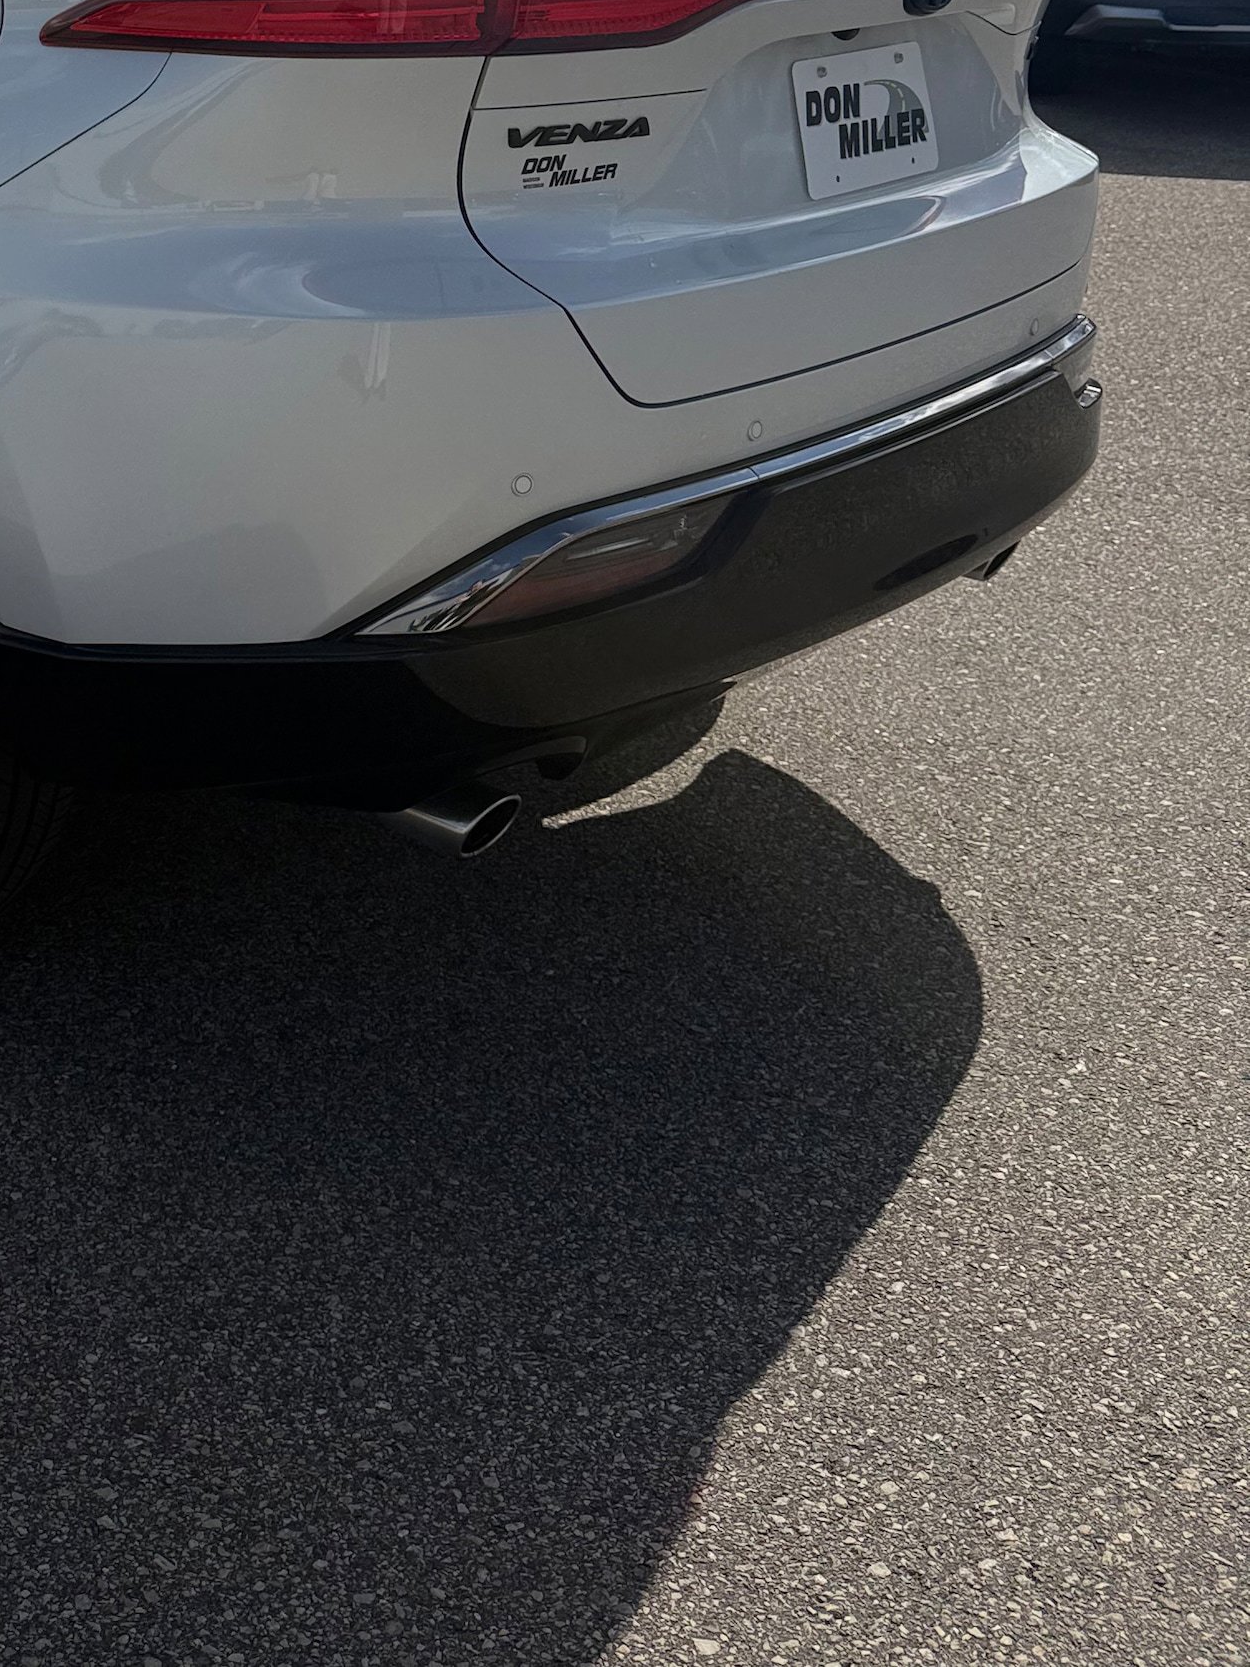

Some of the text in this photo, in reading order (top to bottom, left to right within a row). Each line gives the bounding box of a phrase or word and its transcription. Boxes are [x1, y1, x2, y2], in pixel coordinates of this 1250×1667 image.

[805, 83, 861, 127] DON
[507, 116, 651, 149] VENZA
[838, 108, 928, 160] MILLER
[521, 154, 567, 175] DON
[549, 163, 618, 188] MILLER
